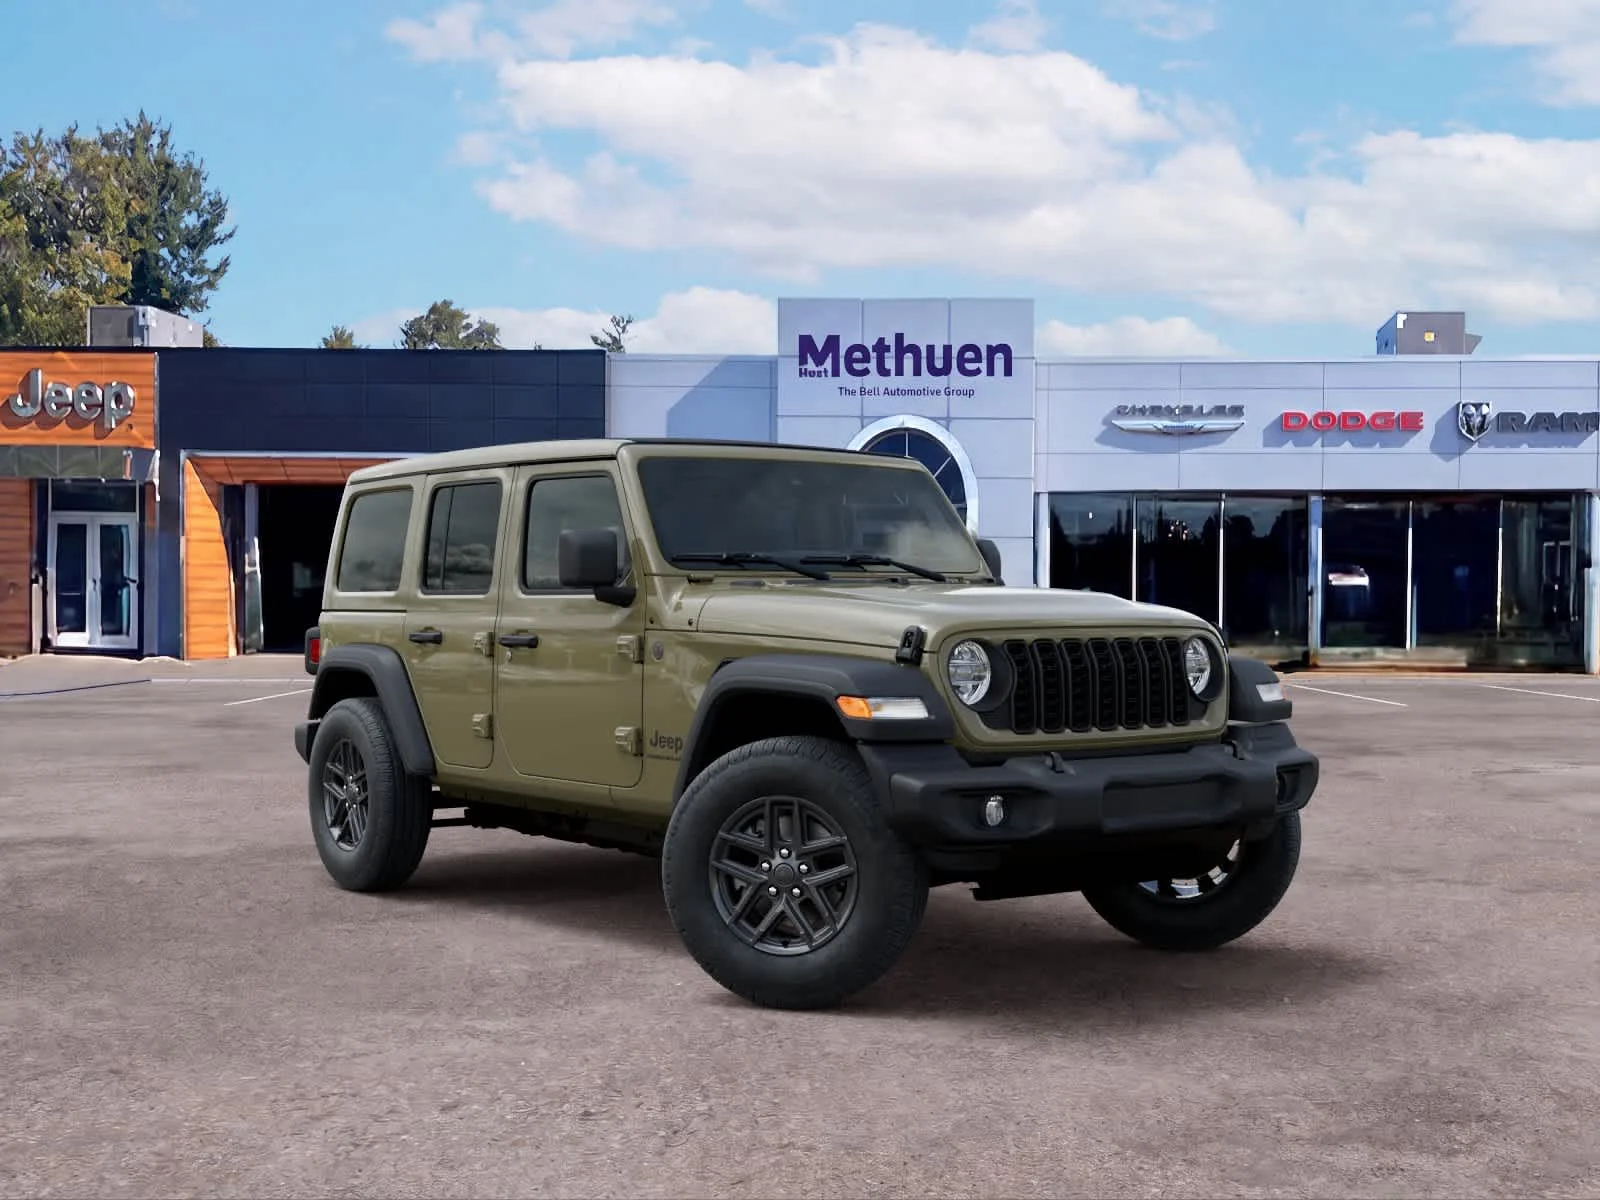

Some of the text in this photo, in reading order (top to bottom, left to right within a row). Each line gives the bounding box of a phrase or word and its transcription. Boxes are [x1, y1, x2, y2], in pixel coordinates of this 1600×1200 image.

[798, 333, 1013, 378] Methuen
[9, 368, 136, 429] Jeep
[838, 386, 975, 399] The Bell Automotive Group
[1281, 411, 1424, 432] DODGE
[1497, 411, 1600, 433] RAM
[649, 729, 684, 755] Jeep
